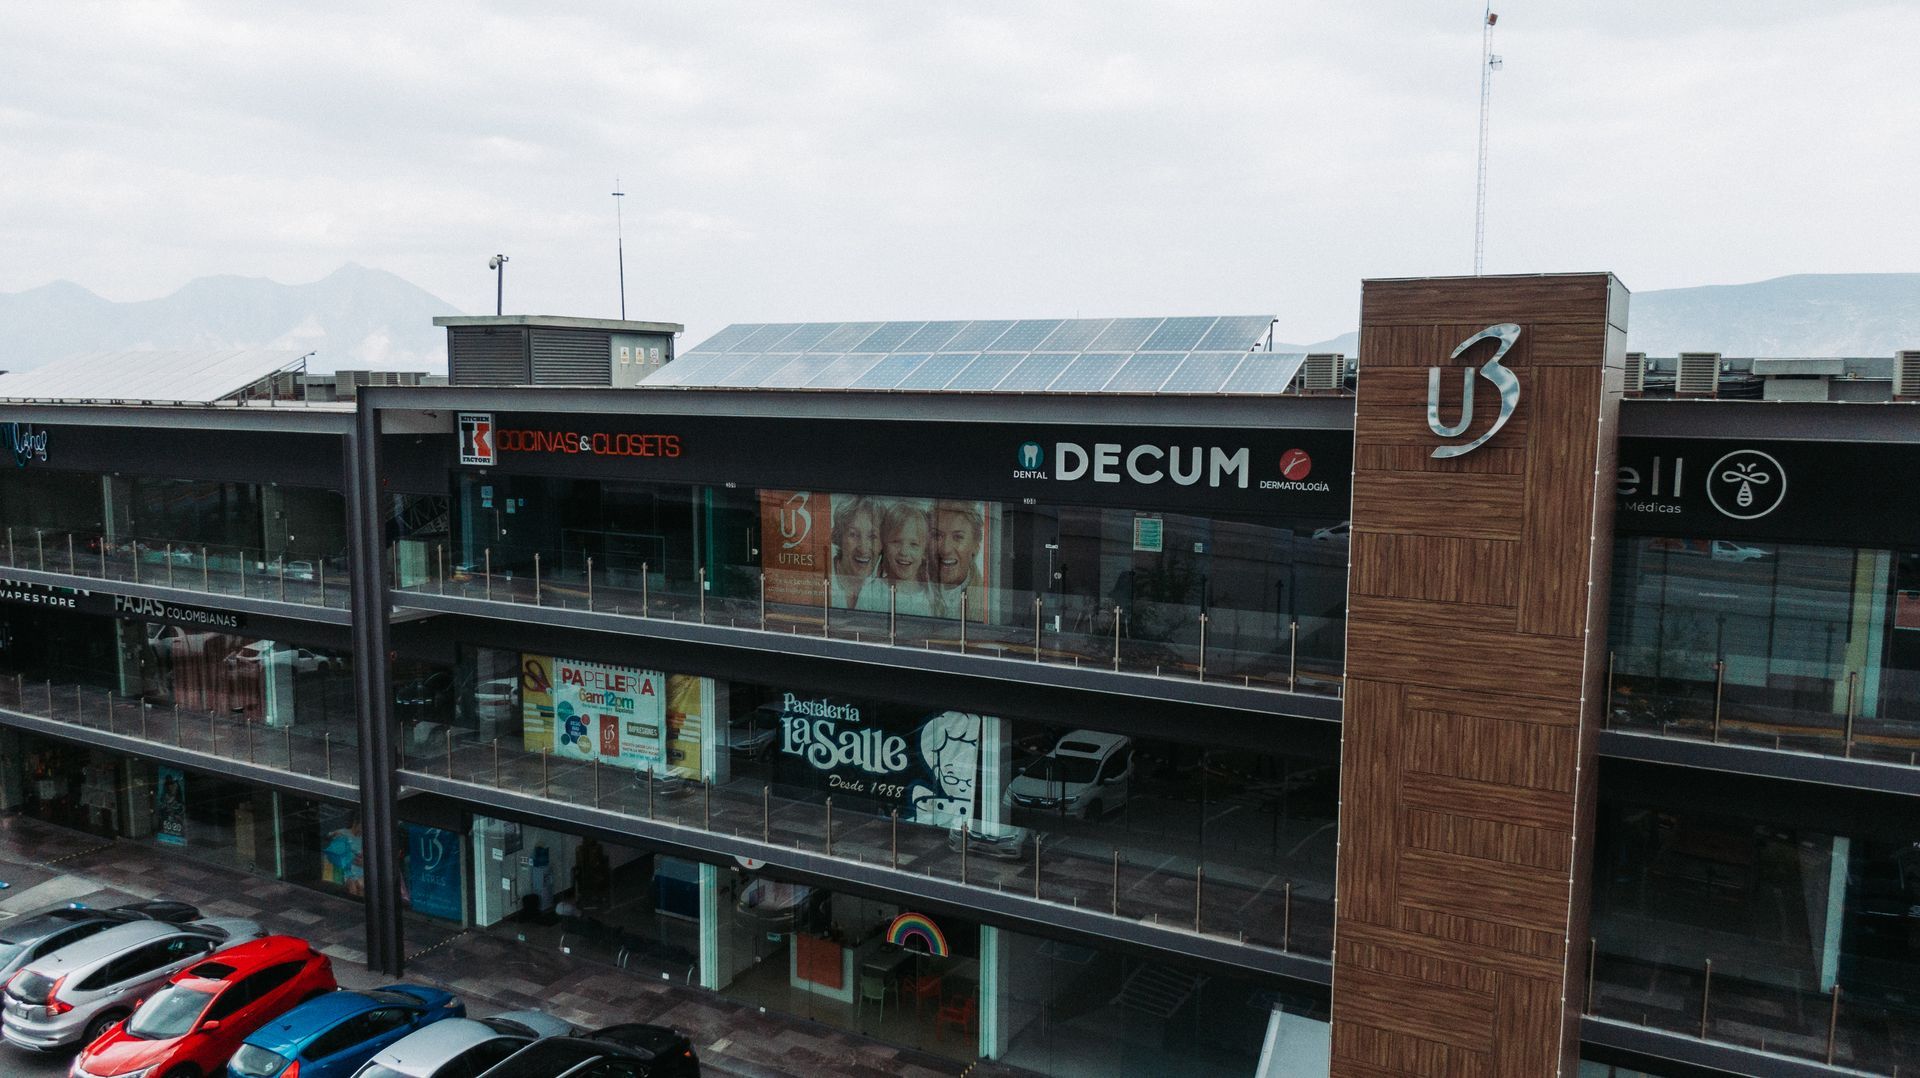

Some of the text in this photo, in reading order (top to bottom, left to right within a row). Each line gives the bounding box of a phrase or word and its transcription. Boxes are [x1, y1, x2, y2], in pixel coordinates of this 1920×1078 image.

[1013, 469, 1048, 480] DENTAL
[1055, 441, 1250, 489] DECUM
[1259, 480, 1330, 492] DERMATOLOGÍA
[1625, 501, 1682, 514] Médicas
[779, 552, 814, 567] UTRES
[0, 589, 76, 608] VAPESTORE
[114, 594, 238, 628] FAJAS COLOMBIANAS
[561, 667, 656, 697] PAPELERÍA
[783, 692, 861, 722] Pastelería
[828, 773, 905, 799] Desde 1988
